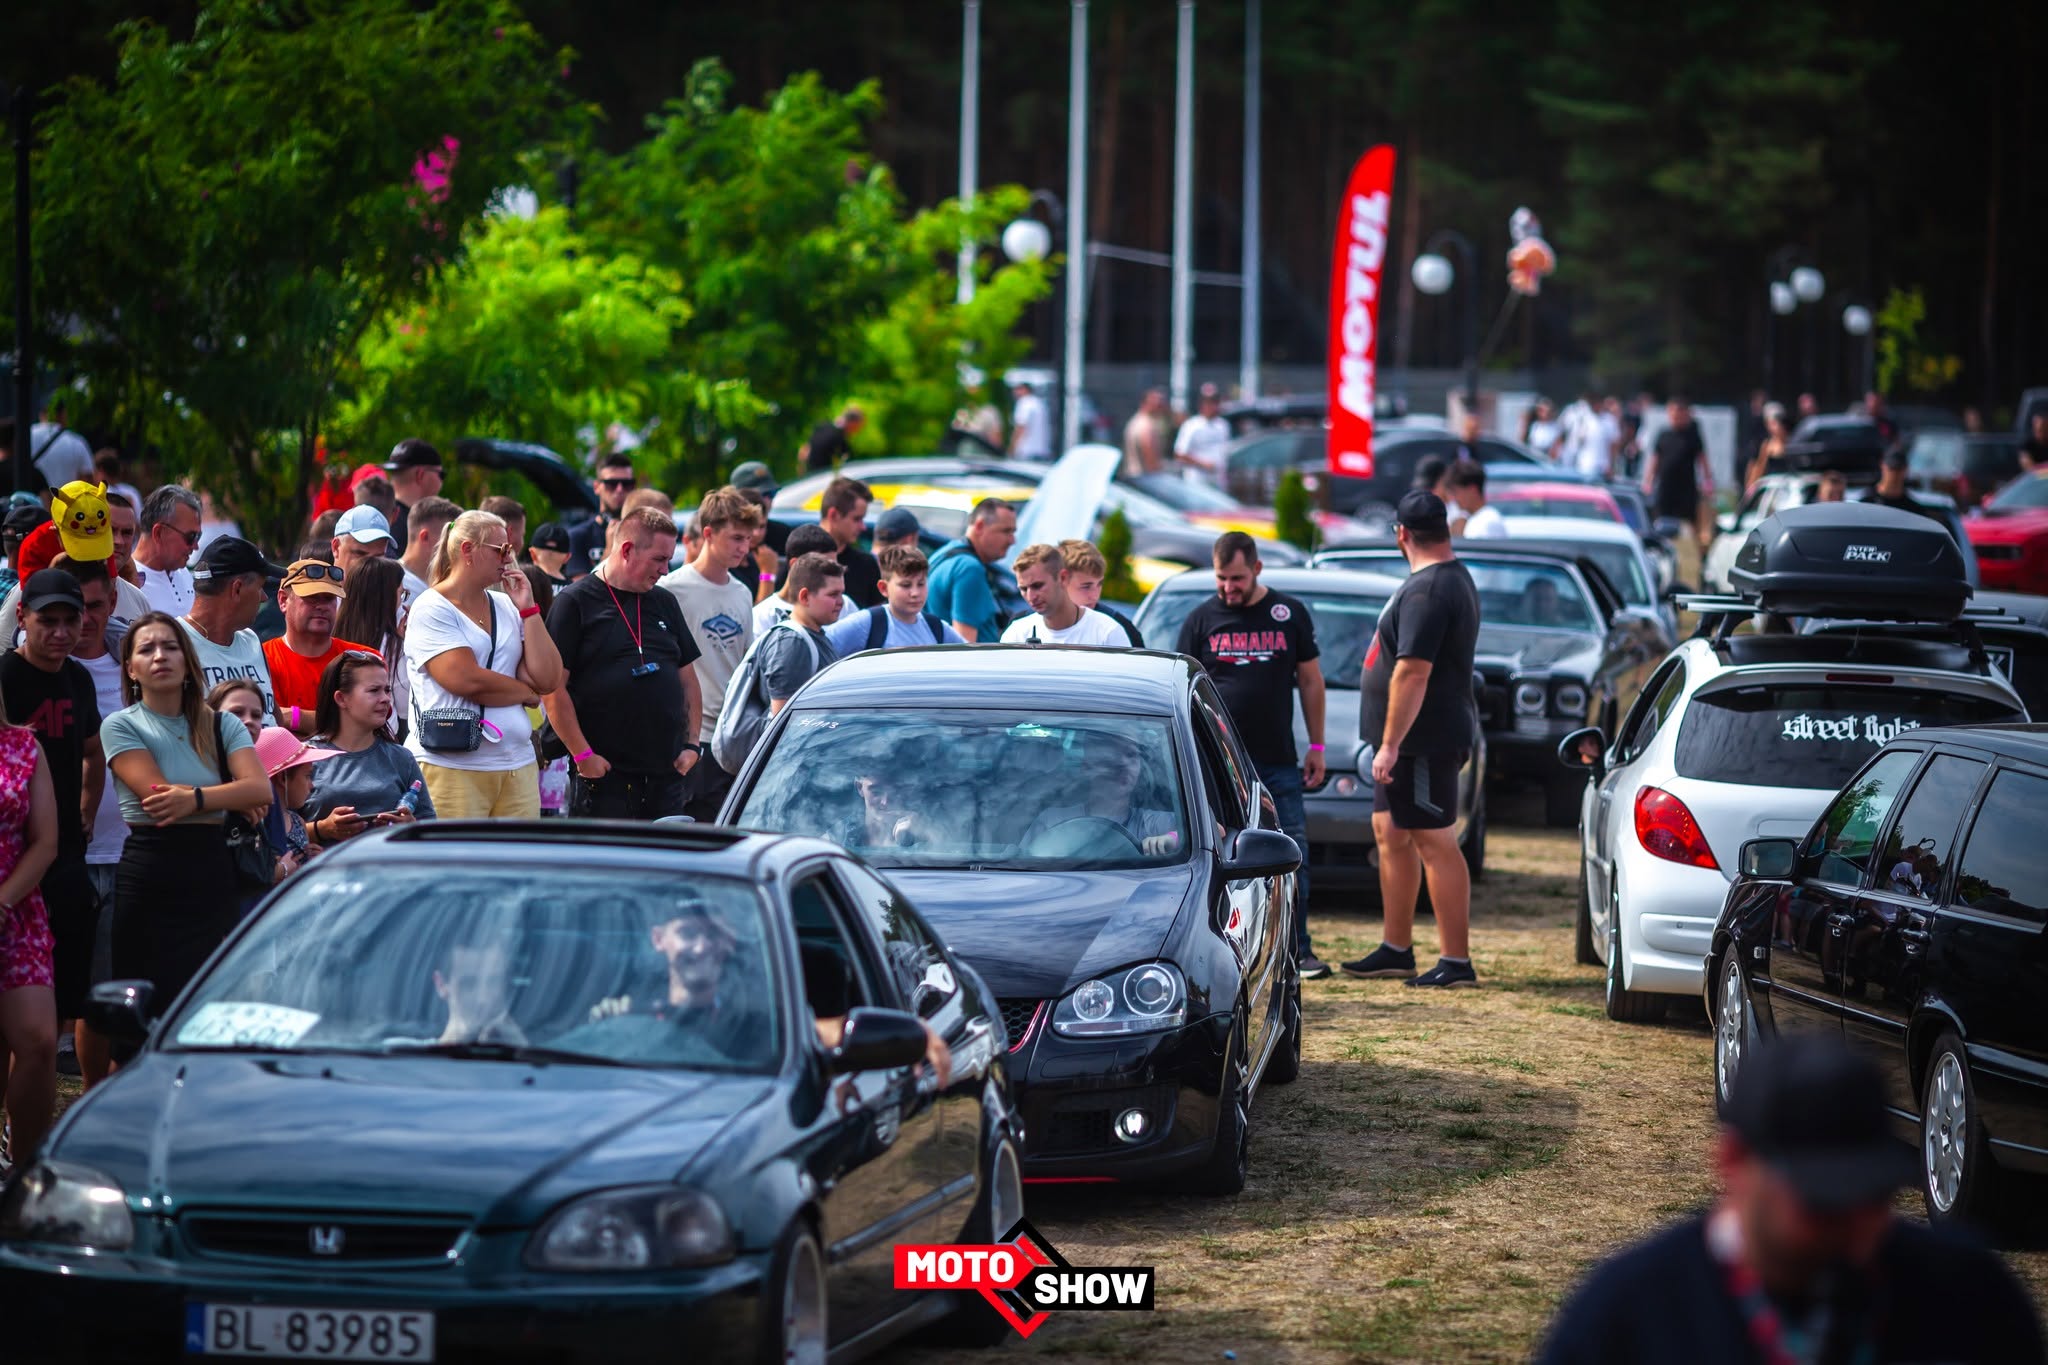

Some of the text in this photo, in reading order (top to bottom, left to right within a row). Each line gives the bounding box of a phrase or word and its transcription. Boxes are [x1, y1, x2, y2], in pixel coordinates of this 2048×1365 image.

[1338, 190, 1391, 424] MOTUL
[1844, 551, 1888, 562] PACK
[1208, 631, 1288, 652] YAMAHA
[202, 665, 265, 687] TRAVEL
[1782, 713, 1860, 742] street
[213, 1307, 266, 1352] BL
[285, 1312, 422, 1357] 83985
